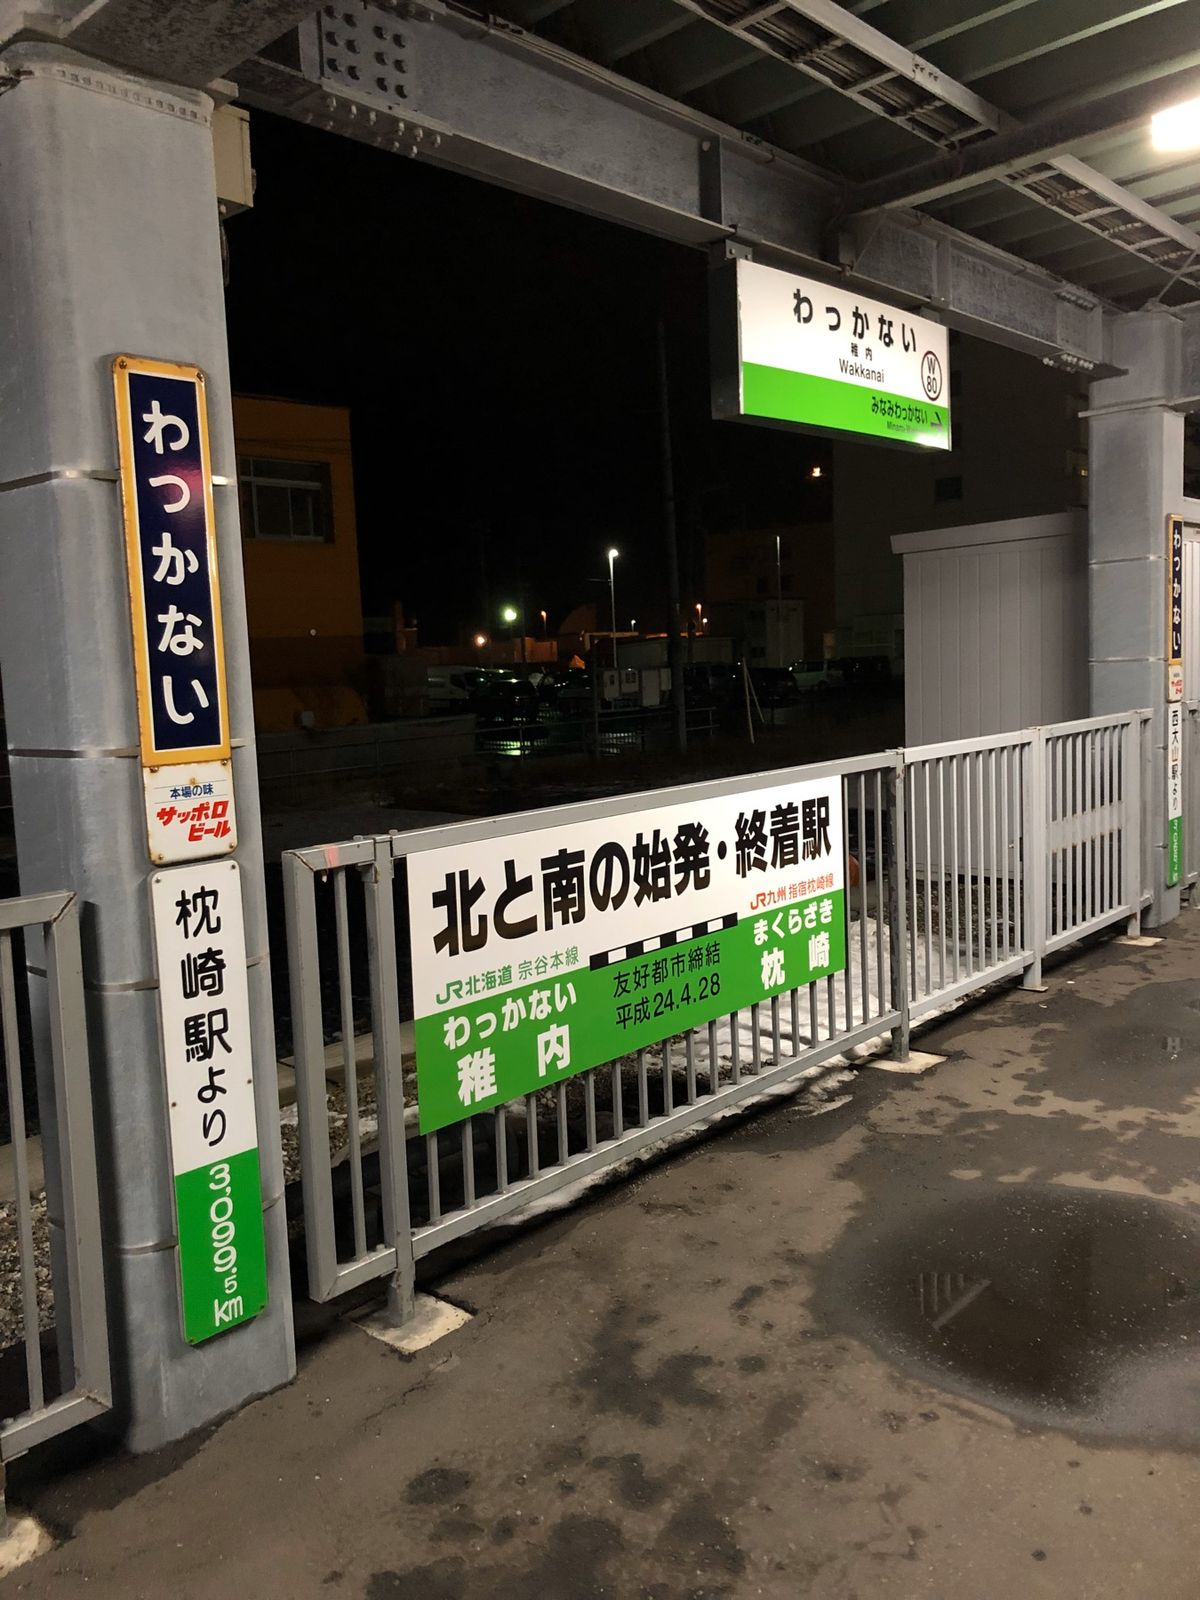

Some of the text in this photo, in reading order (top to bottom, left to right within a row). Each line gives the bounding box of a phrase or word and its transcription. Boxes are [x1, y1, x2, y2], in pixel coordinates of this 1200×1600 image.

[793, 288, 917, 353] わっかない
[851, 342, 873, 361] 稚内
[926, 356, 936, 375] W
[839, 358, 885, 383] Wakkanai
[926, 376, 938, 394] 80
[871, 396, 928, 425] みなみわっかない
[170, 783, 214, 800] 本場の味
[156, 800, 229, 827] サッポロ
[188, 820, 231, 842] ビール
[432, 796, 832, 957] 北と南の始発・終着駅
[788, 872, 835, 900] 指宿枕崎線
[753, 898, 834, 946] まくらざき
[518, 945, 580, 981] 宗谷本線
[613, 940, 721, 998] 友好都市締結
[760, 931, 831, 990] 枕崎
[175, 885, 232, 1147] 枕崎駅より
[443, 982, 577, 1051] わっかない
[615, 972, 721, 1030] 平成24.4.28
[457, 1024, 571, 1107] 稚内
